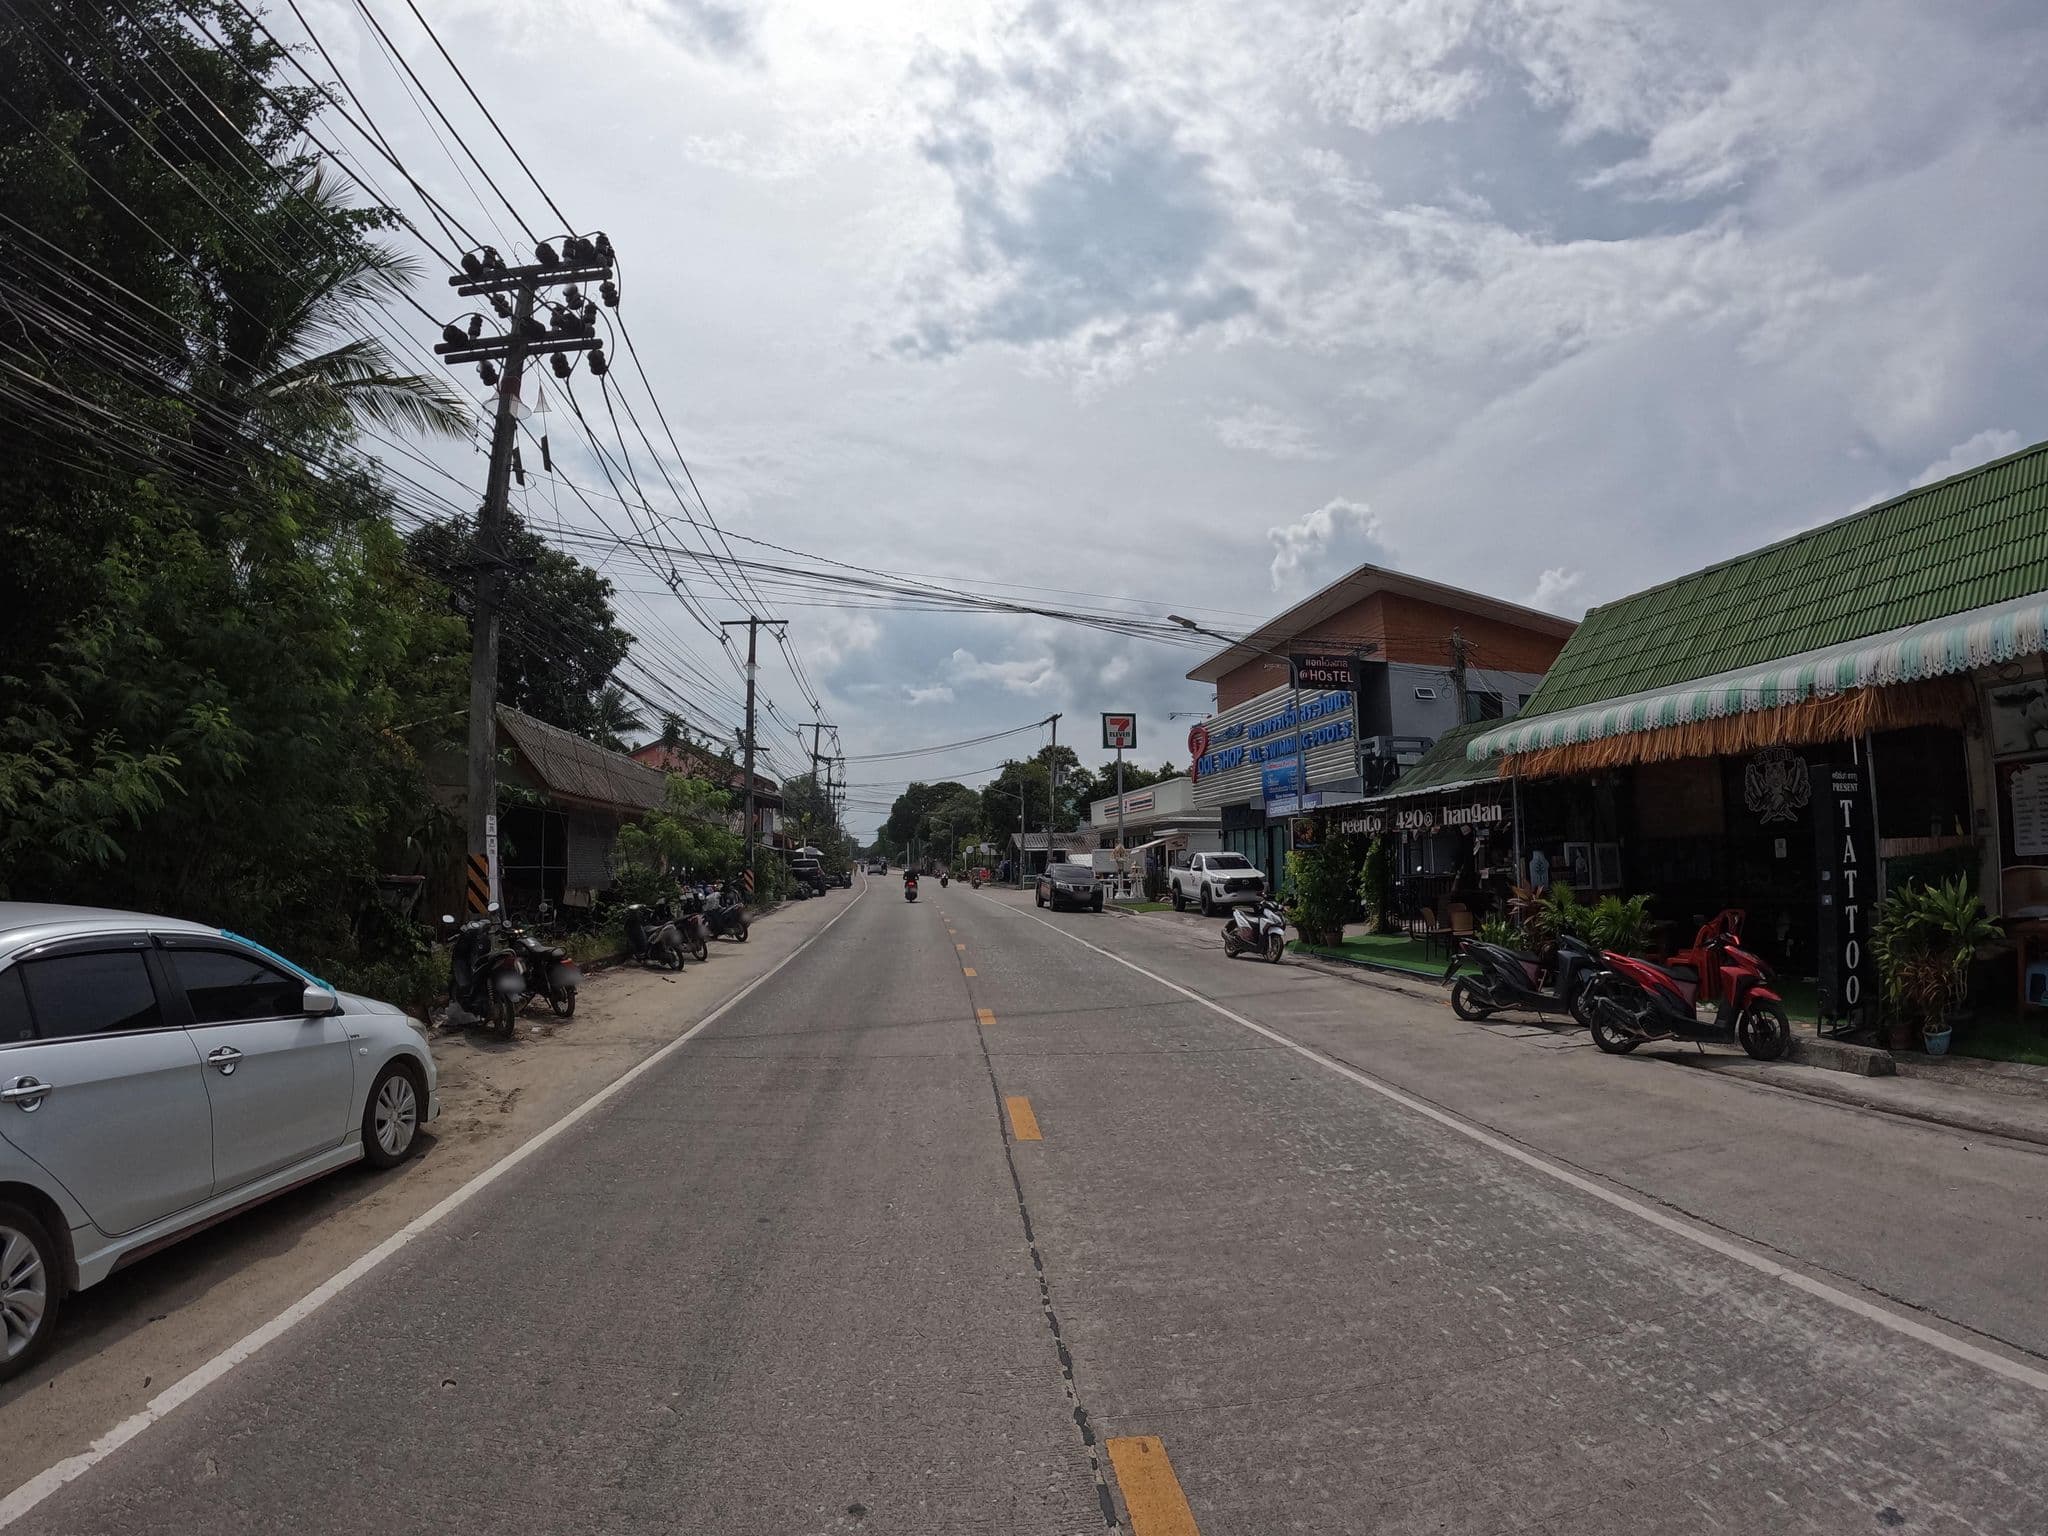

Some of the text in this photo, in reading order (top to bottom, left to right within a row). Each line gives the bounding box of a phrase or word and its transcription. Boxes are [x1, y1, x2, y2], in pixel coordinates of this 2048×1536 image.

[1218, 745, 1244, 771] SHOP
[1248, 747, 1262, 763] ALL
[1311, 720, 1352, 747] POOLS
[1839, 798, 1860, 1005] TATTOO
